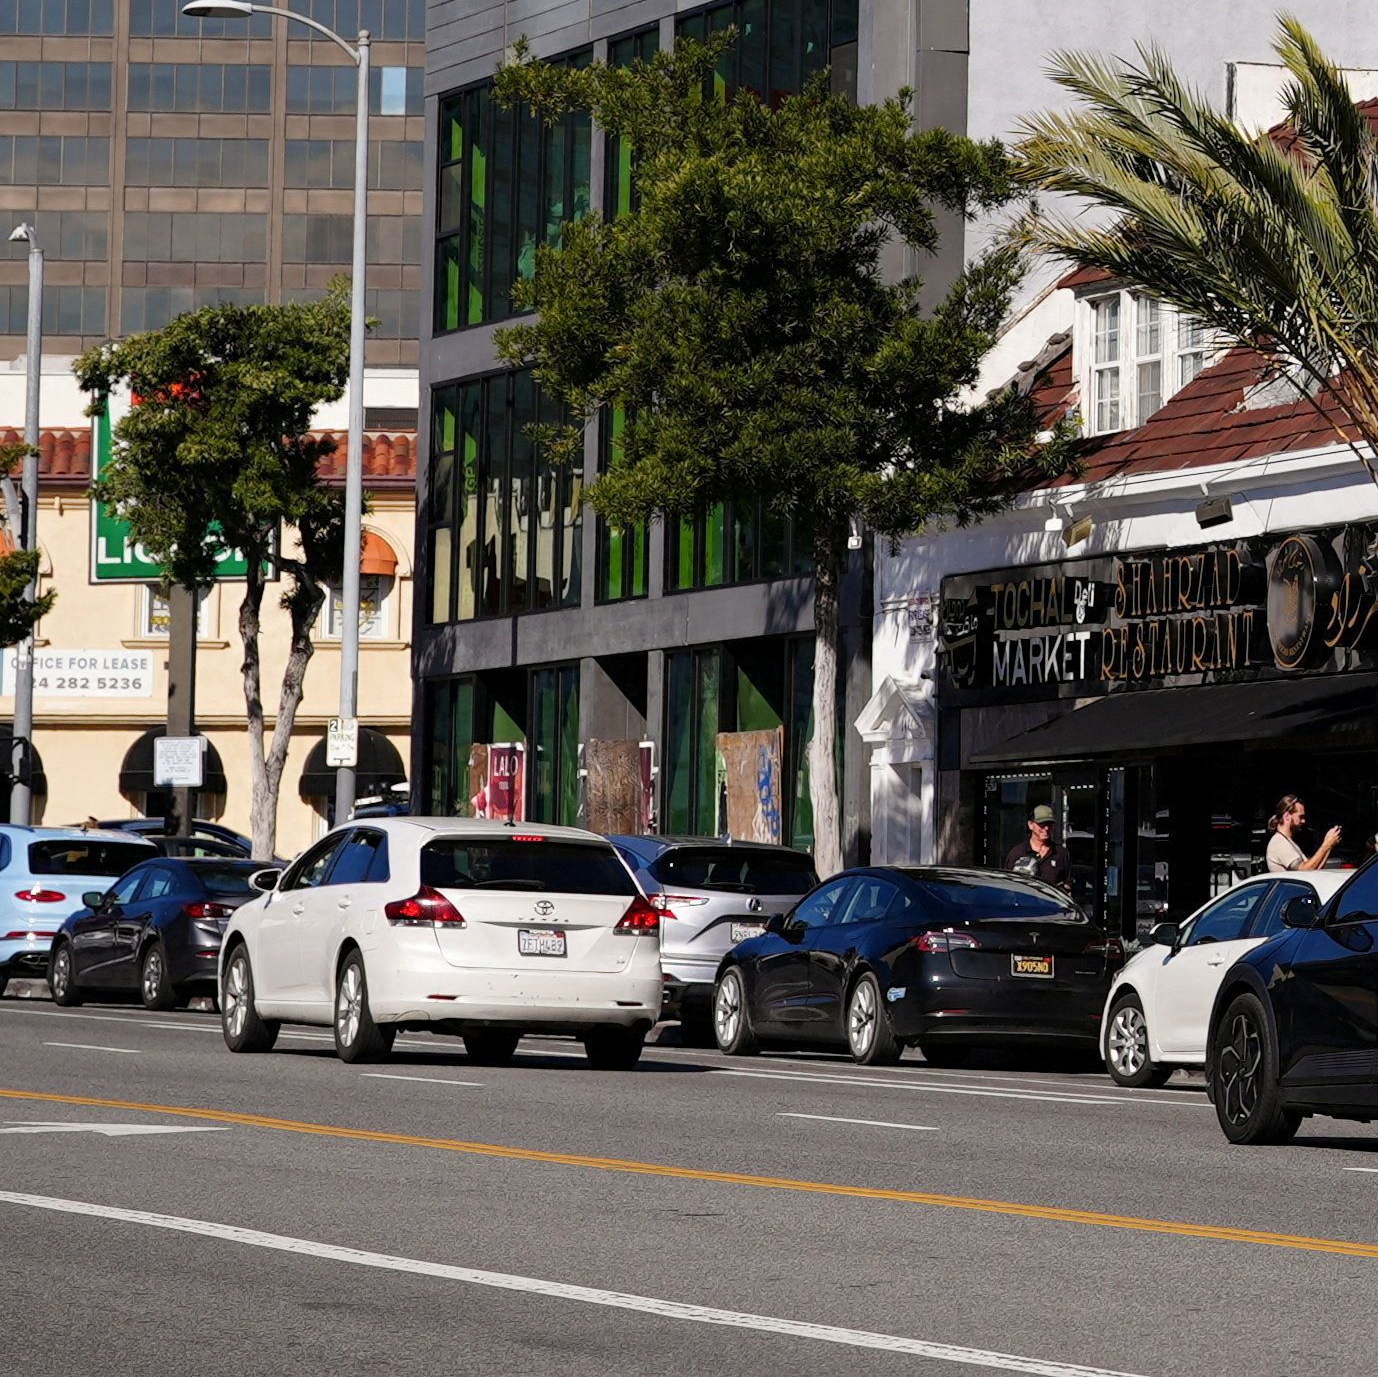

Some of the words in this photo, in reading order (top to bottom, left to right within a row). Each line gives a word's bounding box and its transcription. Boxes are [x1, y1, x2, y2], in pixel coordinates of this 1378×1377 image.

[991, 577, 1073, 630] TOCHAL
[1114, 551, 1242, 619] SHAHRZAD
[69, 657, 97, 670] FOR
[103, 657, 148, 670] LEASE
[993, 631, 1090, 686] MARKET
[1100, 610, 1254, 680] RESTAURANT
[56, 678, 90, 689] 282
[97, 678, 142, 690] 5236
[329, 719, 338, 732] 2
[493, 754, 518, 777] LALO
